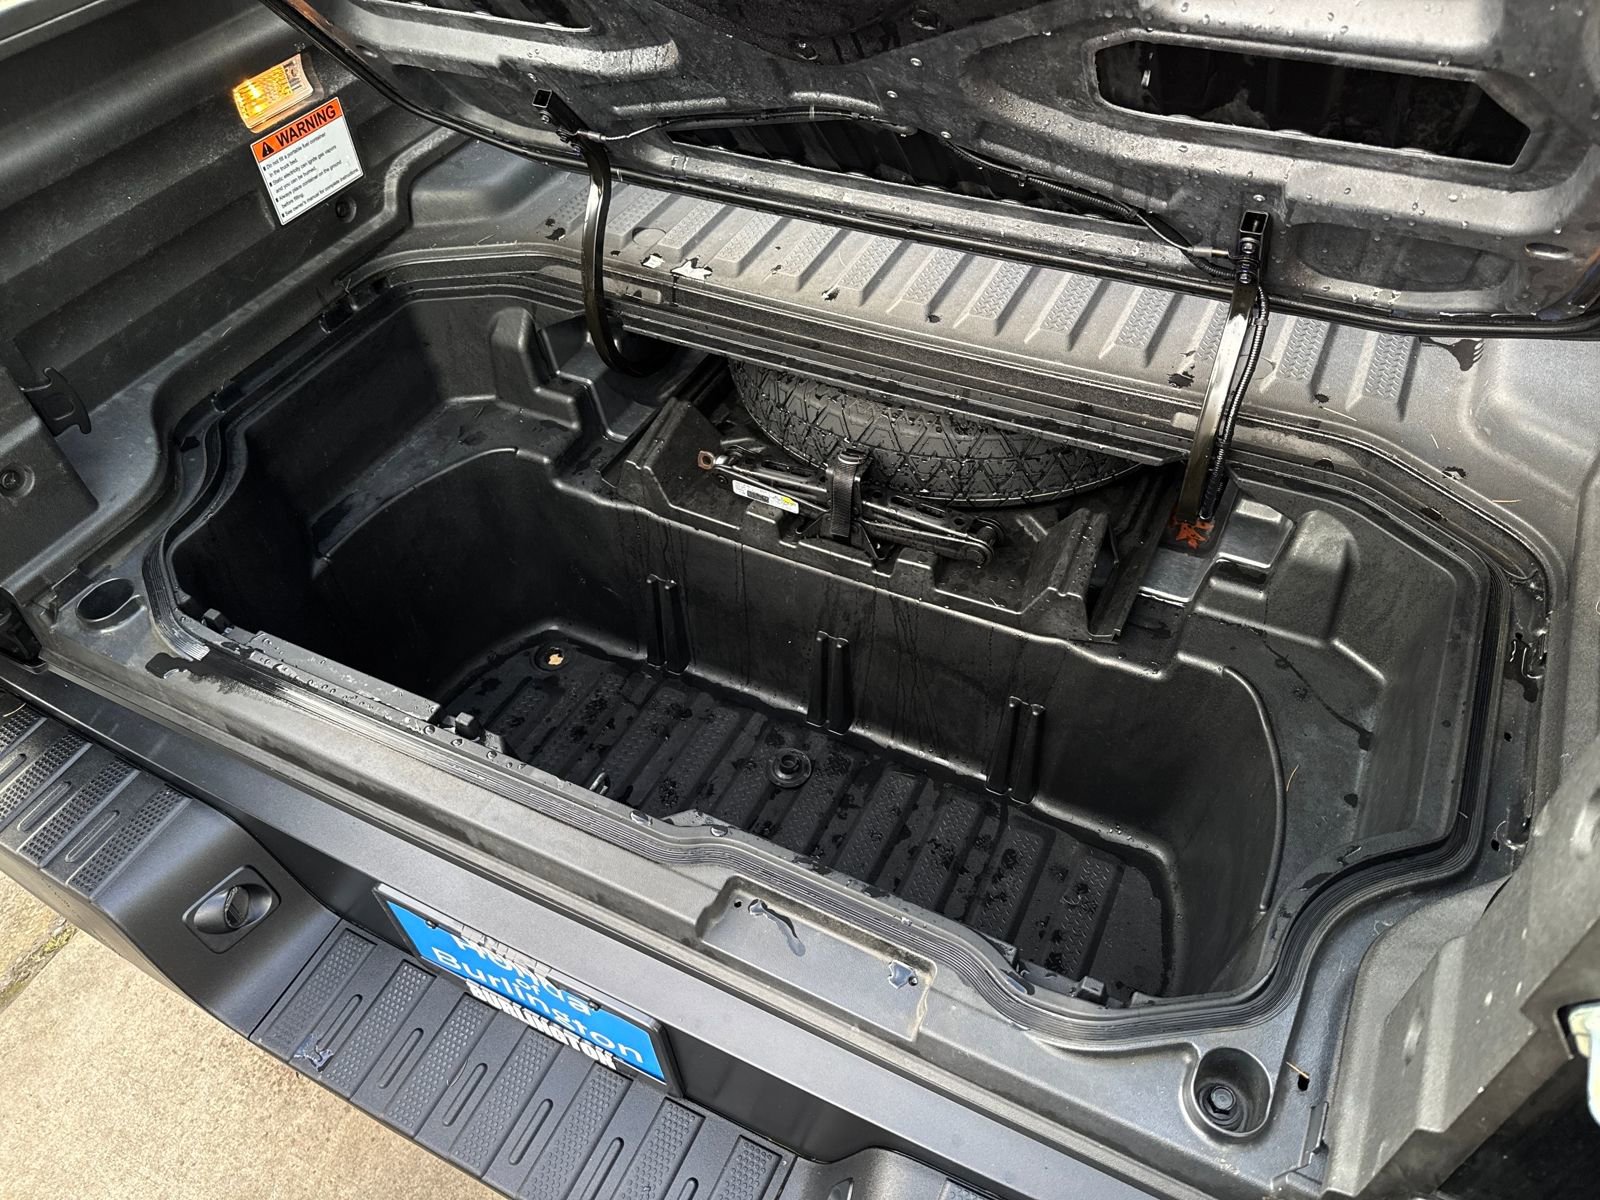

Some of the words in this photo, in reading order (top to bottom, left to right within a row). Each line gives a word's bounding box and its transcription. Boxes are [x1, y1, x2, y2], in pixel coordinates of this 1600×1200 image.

[276, 105, 336, 147] WARNING
[279, 163, 289, 171] truck
[283, 166, 300, 178] electricity
[275, 185, 283, 193] and
[278, 190, 292, 200] Always
[292, 184, 302, 193] place
[302, 174, 318, 186] container
[329, 159, 341, 171] ground
[306, 192, 319, 202] manual
[324, 179, 339, 191] complete
[281, 199, 293, 208] before
[515, 978, 541, 996] of
[431, 946, 644, 1064] Burlington
[465, 978, 617, 1070] BURLINGTON
